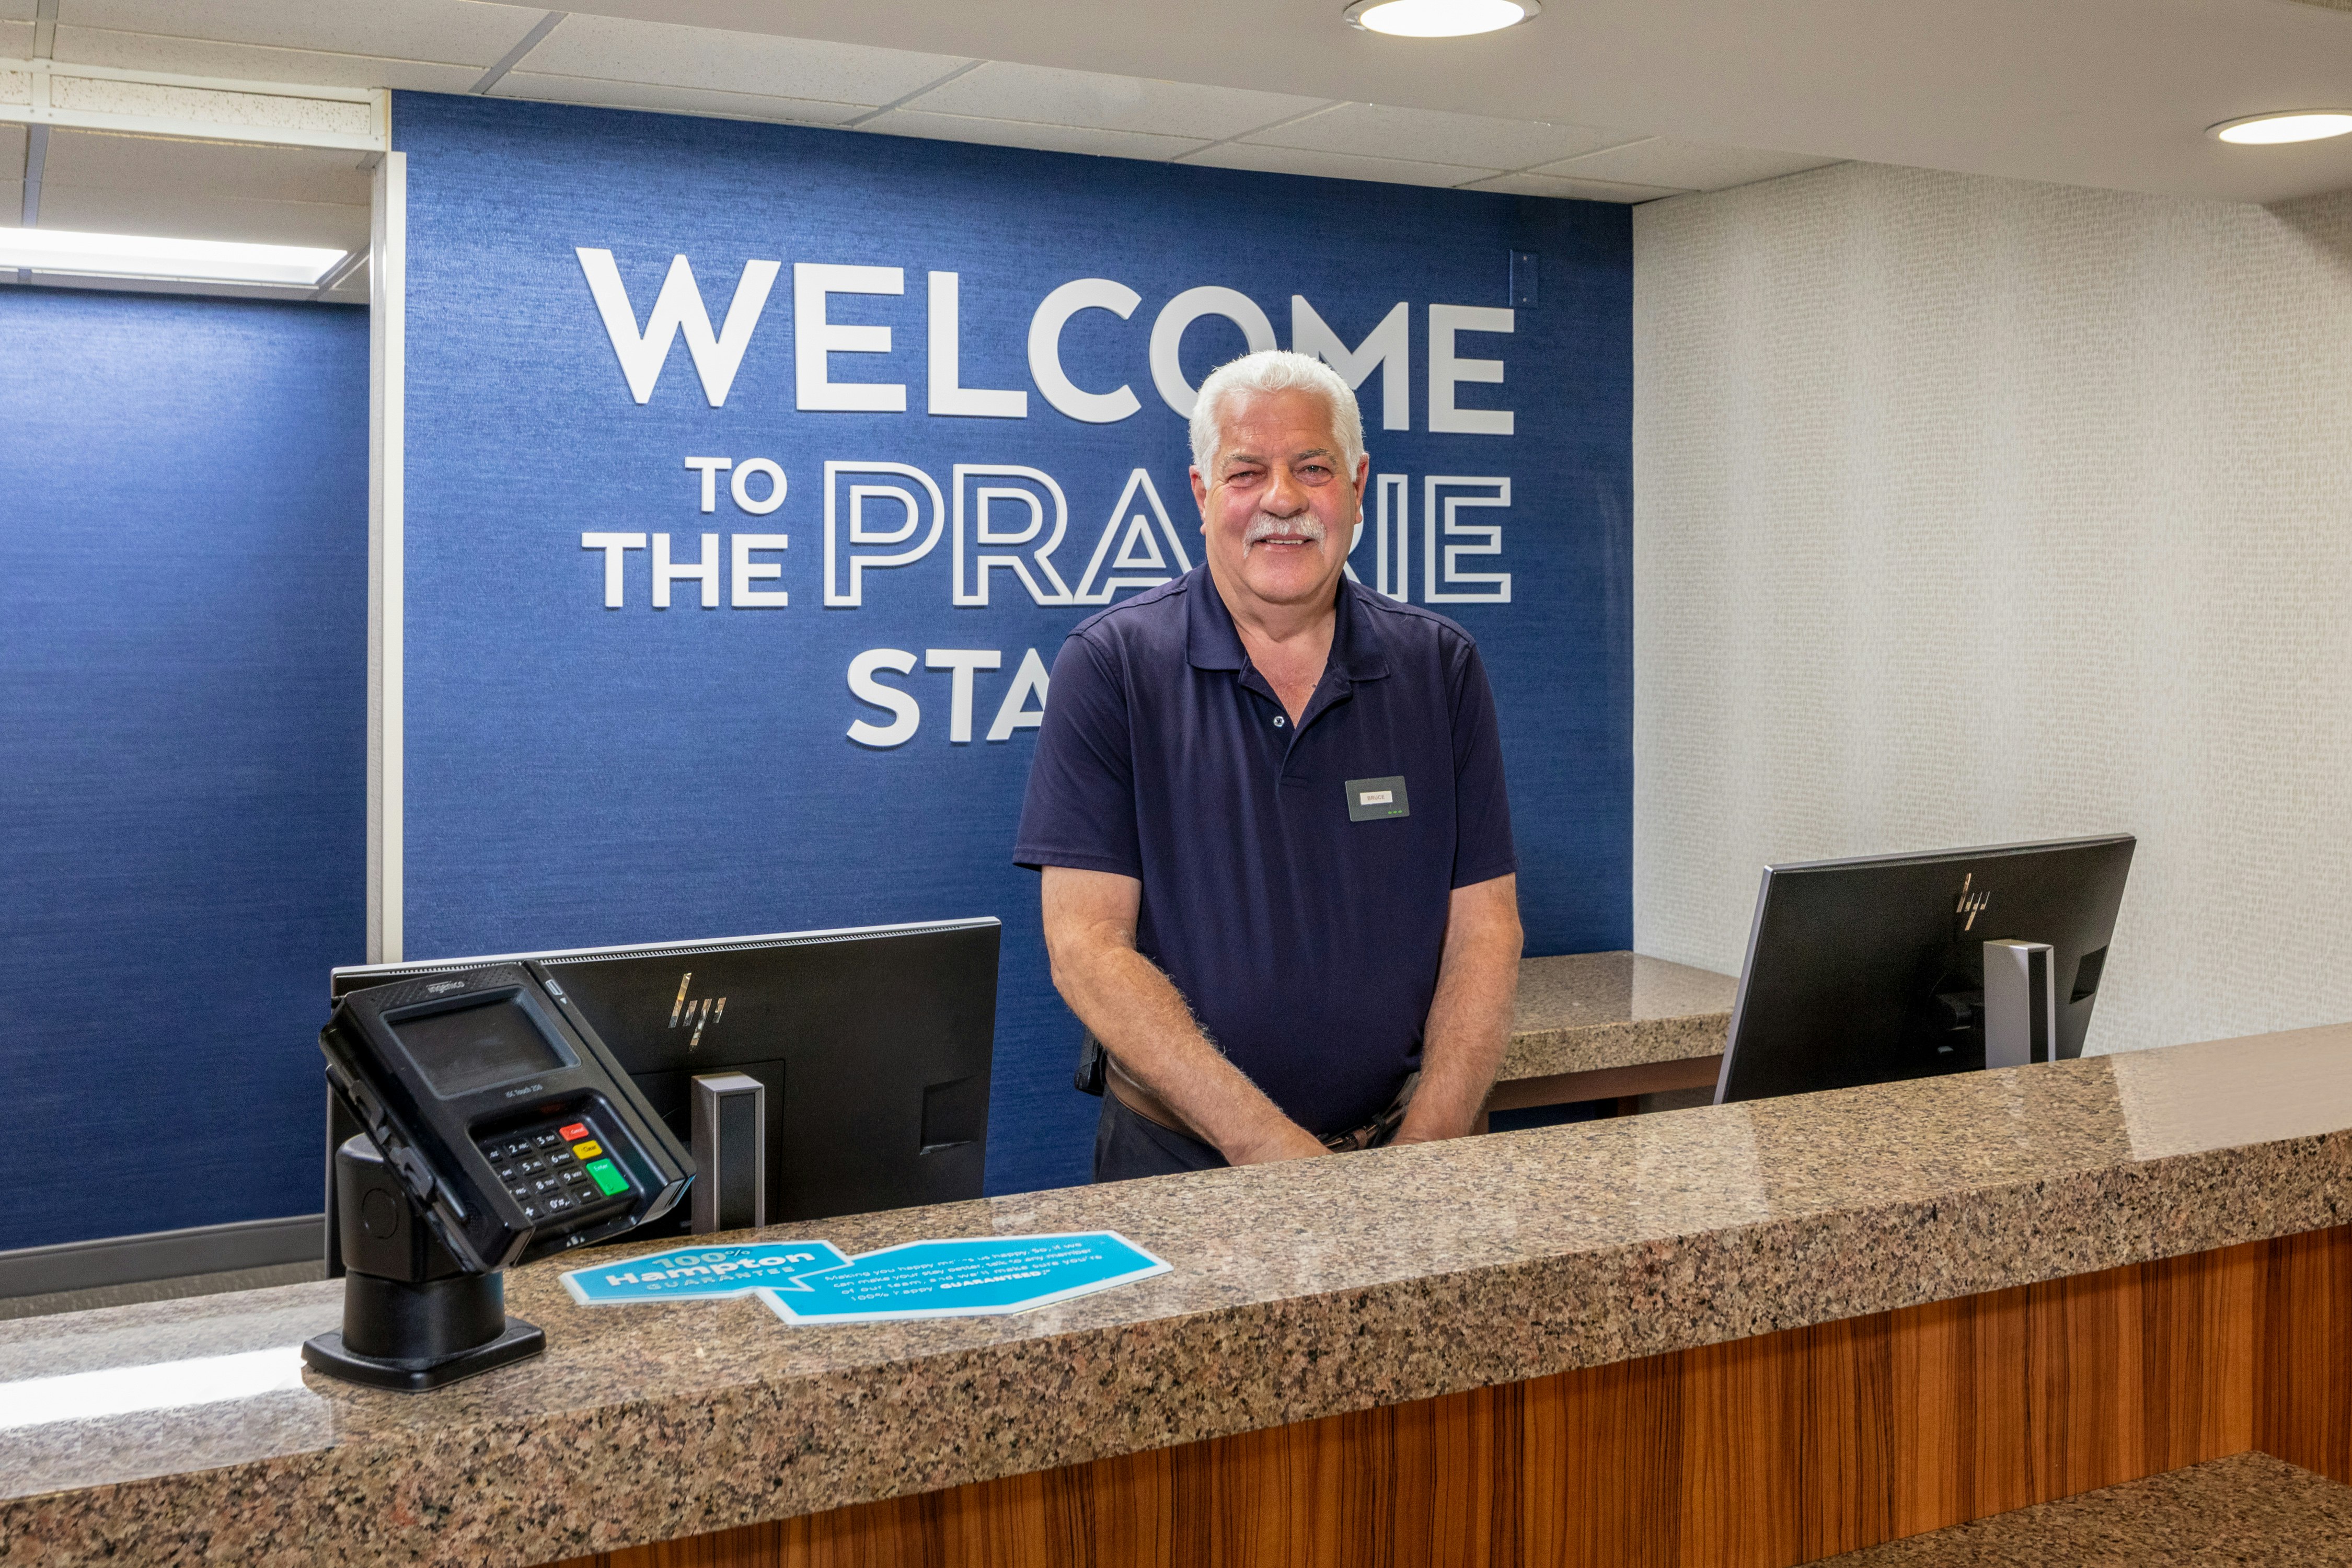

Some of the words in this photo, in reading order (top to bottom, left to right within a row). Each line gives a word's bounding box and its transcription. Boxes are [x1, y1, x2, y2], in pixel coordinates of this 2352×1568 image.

[575, 247, 1514, 435] WELCOME
[684, 456, 788, 514] TO
[824, 460, 1511, 607] PRAIE
[581, 532, 788, 608] THE
[846, 648, 1048, 747] STA
[509, 1145, 517, 1154] 2
[537, 1136, 545, 1145] 3
[522, 1162, 531, 1171] 5
[551, 1155, 559, 1163] 6
[536, 1181, 544, 1190] 8
[563, 1172, 571, 1181] 9
[652, 1249, 751, 1269] 100%
[858, 1276, 891, 1284] make
[892, 1272, 918, 1281] your
[1046, 1248, 1091, 1259] member
[605, 1252, 815, 1286] Hampton
[646, 1266, 795, 1290] GUARANTEE
[824, 1271, 871, 1281] Making
[897, 1263, 933, 1271] happy
[929, 1274, 954, 1283] and
[994, 1265, 1029, 1274] make
[850, 1292, 890, 1301] 100%
